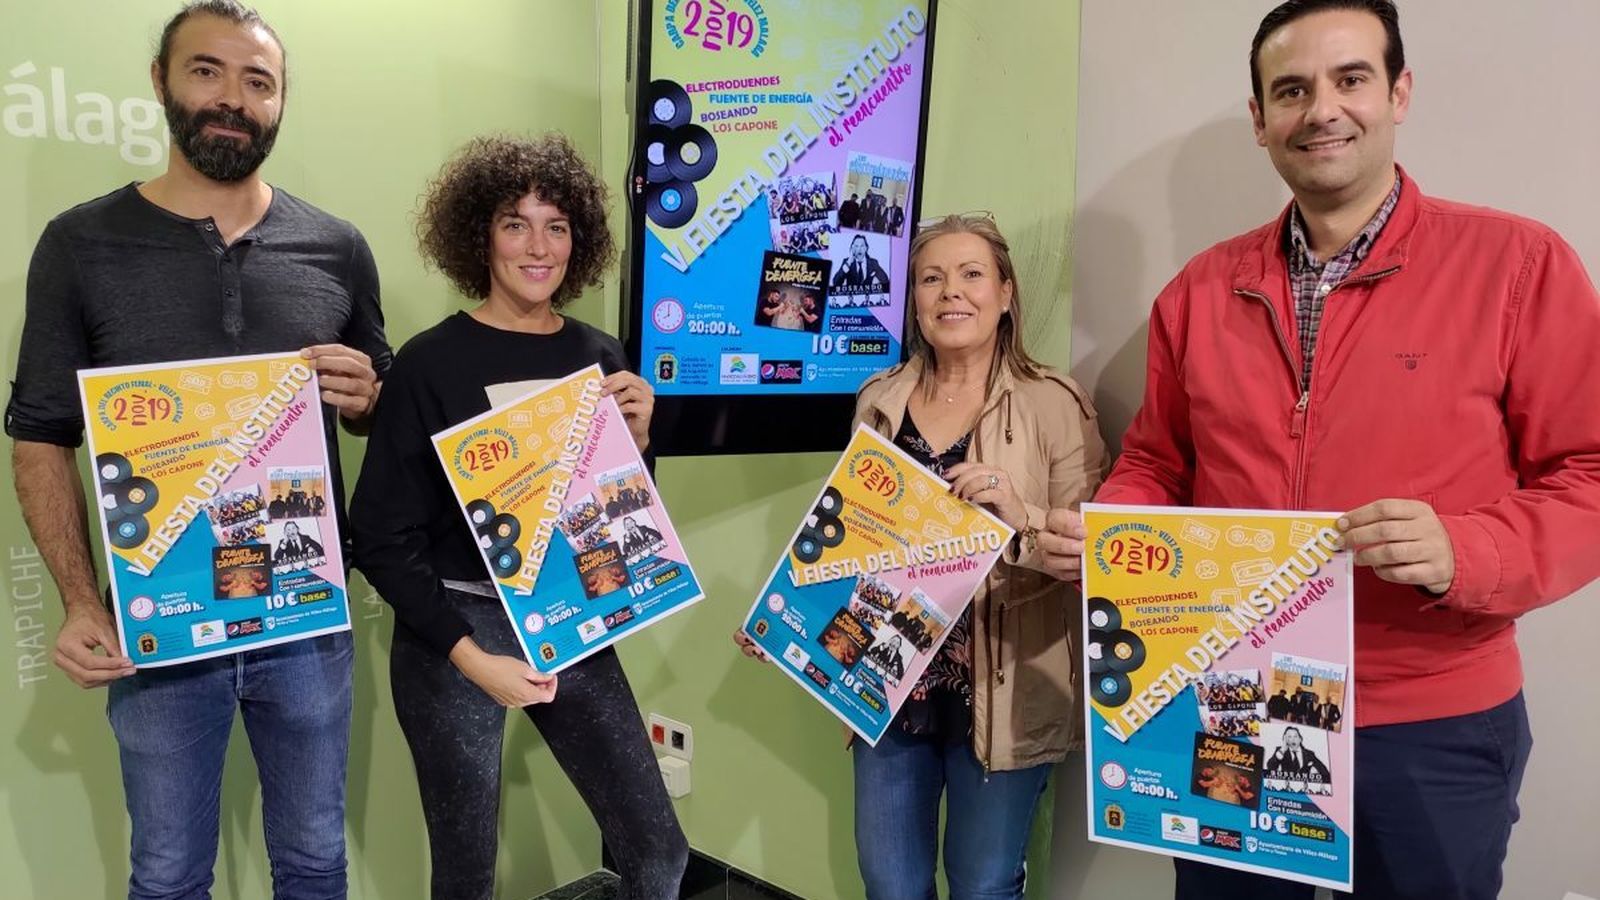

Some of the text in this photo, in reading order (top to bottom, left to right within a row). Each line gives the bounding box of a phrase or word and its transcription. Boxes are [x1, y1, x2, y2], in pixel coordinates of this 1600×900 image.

[684, 0, 702, 36] 2
[727, 12, 754, 48] 19
[686, 75, 780, 93] ELECTRODUENDES
[709, 92, 812, 103] FUENTE DE ENERGÍA
[828, 63, 910, 146] el reencuentro
[2, 60, 170, 166] álag
[700, 106, 758, 122] BOSEANDO
[713, 121, 777, 132] LOS CAPONE
[658, 4, 927, 272] V FIESTA DEL INSTITUTO
[688, 320, 726, 334] 20:00
[112, 397, 128, 421] 2
[147, 396, 172, 420] 19
[124, 430, 199, 457] ELECTRODUENDES
[247, 455, 260, 466] el
[258, 400, 306, 456] reencuentro
[139, 454, 186, 473] BOSEANDO
[144, 449, 177, 459] FUENTE
[463, 448, 480, 471] 2
[488, 437, 512, 463] 19
[127, 557, 150, 576] V
[141, 495, 205, 562] FIESTA
[194, 458, 238, 496] DEL
[225, 363, 310, 458] INSTITUTO
[151, 460, 204, 478] LOS CAPONE
[856, 456, 873, 478] 2
[874, 474, 898, 500] 19
[500, 481, 524, 497] FUENTE
[514, 379, 602, 596] V FIESTA DEL INSTITUTO
[875, 523, 883, 531] DE
[788, 530, 1000, 587] V FIESTA DEL INSTITUTO
[1110, 539, 1123, 565] 2
[1145, 545, 1169, 572] 19
[907, 557, 979, 579] el reencuentro
[158, 602, 191, 617] 20:00
[1115, 591, 1197, 606] ELECTRODUENDES
[1188, 604, 1231, 612] ENERGÍA
[10, 546, 48, 690] TRAPICHE
[1129, 615, 1179, 628] BOSEANDO
[1250, 576, 1334, 648] el reencuentro
[1104, 527, 1343, 742] V FIESTA DEL INSTITUTO
[1130, 781, 1164, 797] 20:00
[1268, 796, 1301, 809] Entradas
